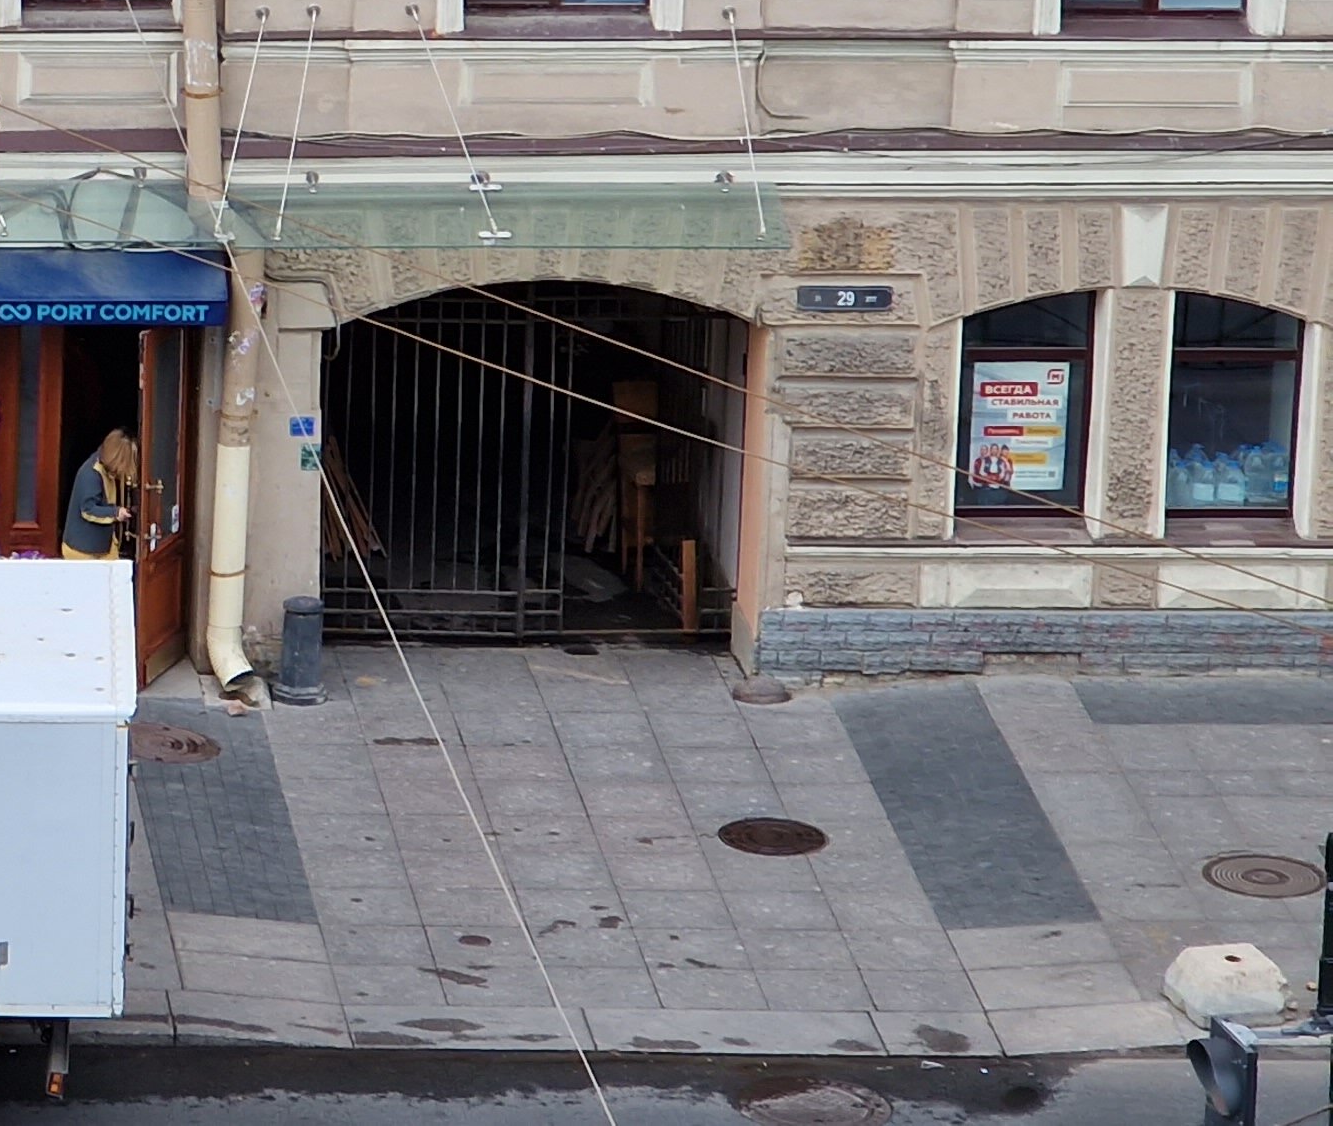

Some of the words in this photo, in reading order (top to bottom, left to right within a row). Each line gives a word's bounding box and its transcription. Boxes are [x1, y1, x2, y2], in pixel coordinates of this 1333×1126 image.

[836, 290, 856, 306] 29
[37, 303, 96, 321] PORT
[99, 303, 210, 322] COMFORT
[984, 385, 1033, 395] ВСЕГДА
[991, 398, 1060, 406] СТАБИЛЬНАЯ
[1012, 412, 1052, 420] РАБОТА
